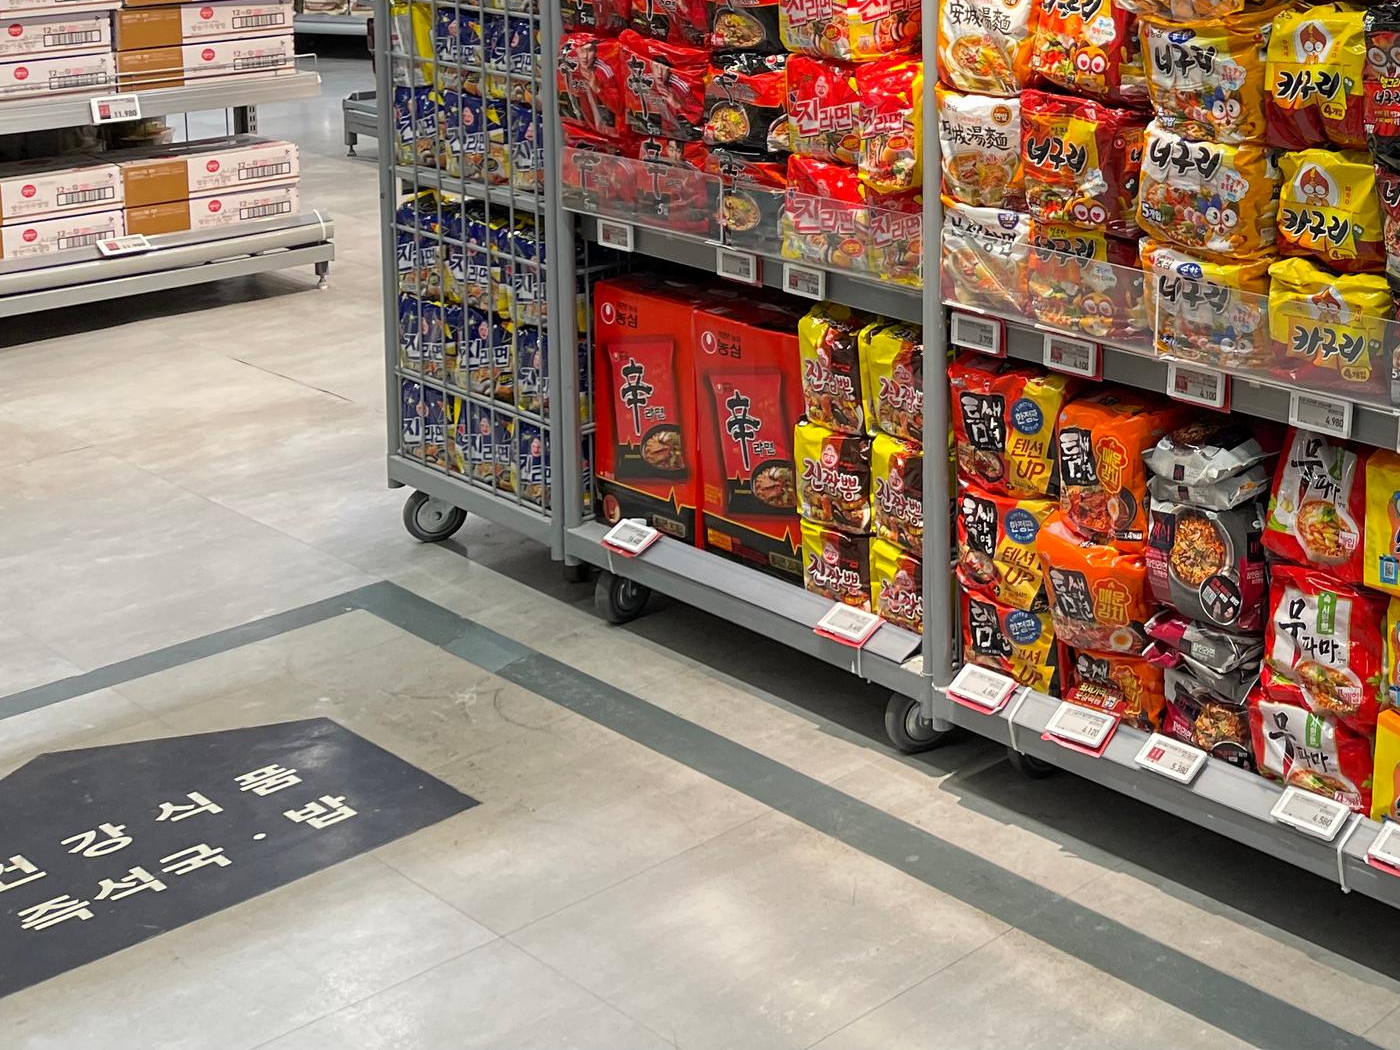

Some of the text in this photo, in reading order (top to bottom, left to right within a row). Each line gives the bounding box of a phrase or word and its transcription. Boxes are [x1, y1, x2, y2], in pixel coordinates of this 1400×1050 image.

[950, 3, 1011, 35] 安城湯麵
[1155, 44, 1216, 77] 너구리
[1274, 69, 1343, 101] 카구리
[797, 96, 853, 137] 진라면
[1027, 139, 1088, 175] 너구리
[1148, 137, 1222, 178] 너구리
[794, 195, 855, 234] 진라면
[1281, 208, 1350, 245] 카구리
[1159, 276, 1230, 314] 너구리
[615, 311, 639, 329] 농심
[716, 340, 742, 360] 농심
[1294, 325, 1365, 363] 카구리
[804, 357, 855, 398] 진짬뽕
[620, 357, 666, 437] 辛 라면
[725, 389, 776, 472] 辛 라면
[1014, 410, 1039, 425] 한정판
[1325, 416, 1345, 429] 4.980
[1011, 438, 1044, 459] 텐션
[801, 459, 860, 502] 진짬뽕
[1016, 459, 1046, 481] UP
[1002, 546, 1036, 567] 텐션
[807, 553, 862, 596] 진짬뽕
[1003, 567, 1035, 587] UP
[1098, 588, 1125, 606] 매운
[1098, 605, 1125, 624] 김치
[1279, 598, 1340, 665] 무파마
